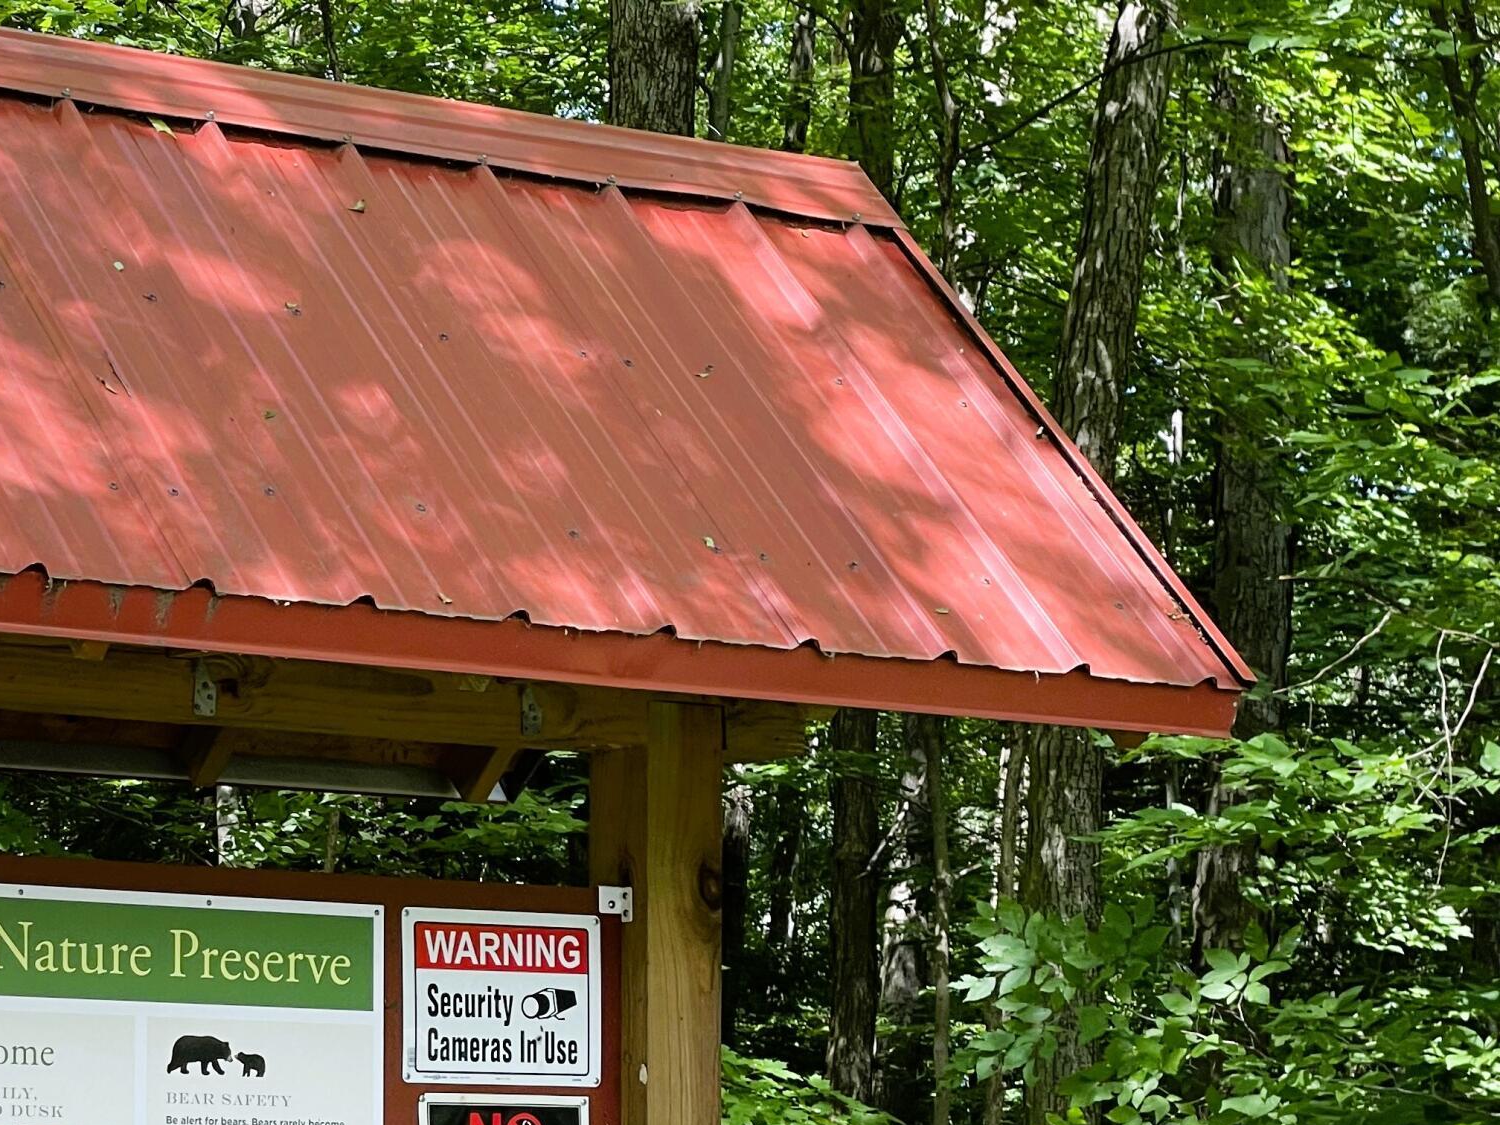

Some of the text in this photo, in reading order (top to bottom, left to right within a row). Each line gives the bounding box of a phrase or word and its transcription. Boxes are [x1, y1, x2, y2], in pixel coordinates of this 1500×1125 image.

[169, 930, 350, 985] Preserve
[424, 929, 580, 968] WARNING
[427, 983, 513, 1026] Security
[427, 1027, 577, 1064] Cameras In Use
[11, 1104, 62, 1118] DUSK
[167, 1092, 291, 1107] BEAR SAFETY
[166, 1115, 178, 1124] Be
[180, 1116, 202, 1125] alert
[204, 1116, 218, 1125] for
[220, 1116, 248, 1125] bears.
